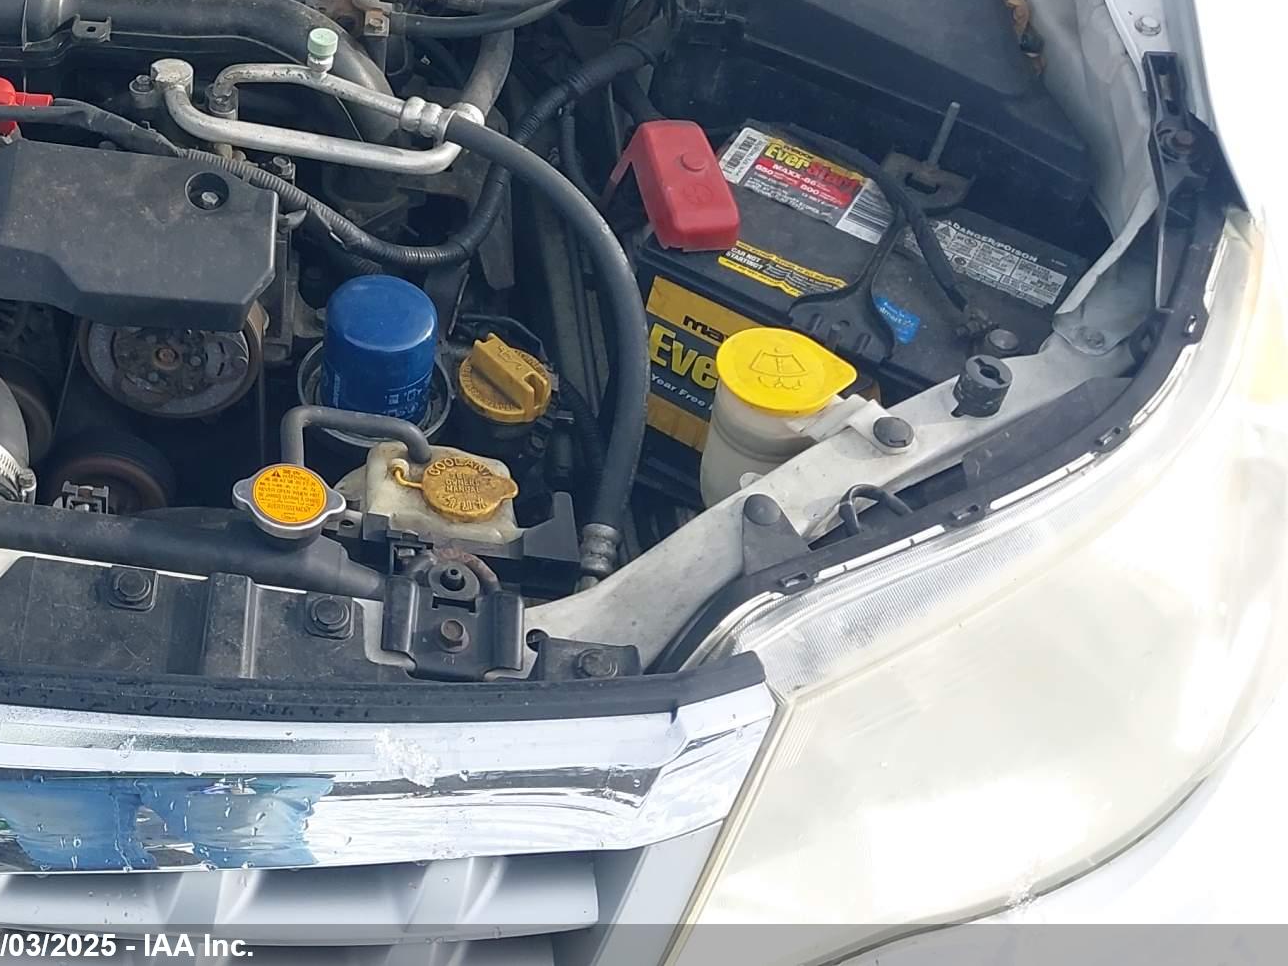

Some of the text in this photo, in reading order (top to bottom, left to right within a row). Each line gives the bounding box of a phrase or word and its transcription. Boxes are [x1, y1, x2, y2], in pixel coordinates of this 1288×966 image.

[952, 221, 1039, 263] DANGER/POISON
[730, 247, 762, 263] CAR NOT
[679, 388, 706, 409] Free
[427, 456, 493, 476] COOLANT
